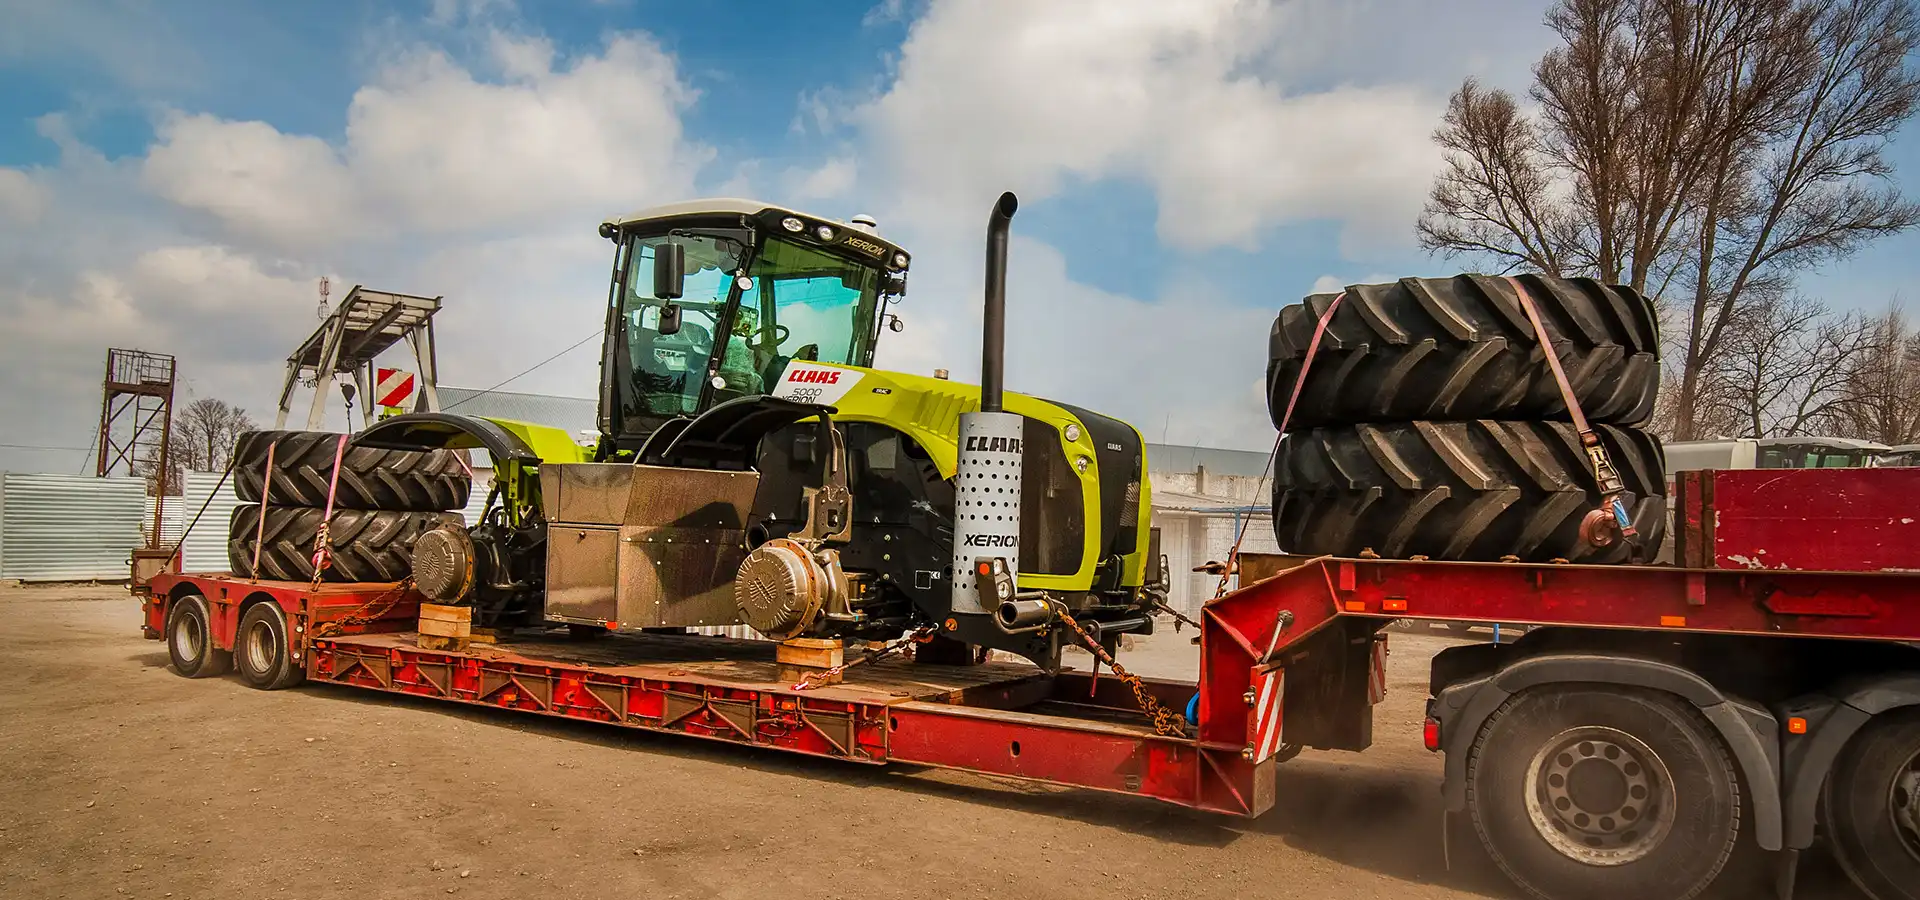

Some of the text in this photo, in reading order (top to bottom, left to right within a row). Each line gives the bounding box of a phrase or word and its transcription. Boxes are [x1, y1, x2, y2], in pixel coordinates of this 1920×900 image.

[844, 237, 886, 256] XERION
[788, 370, 841, 384] CLAAS
[792, 388, 823, 396] 5000
